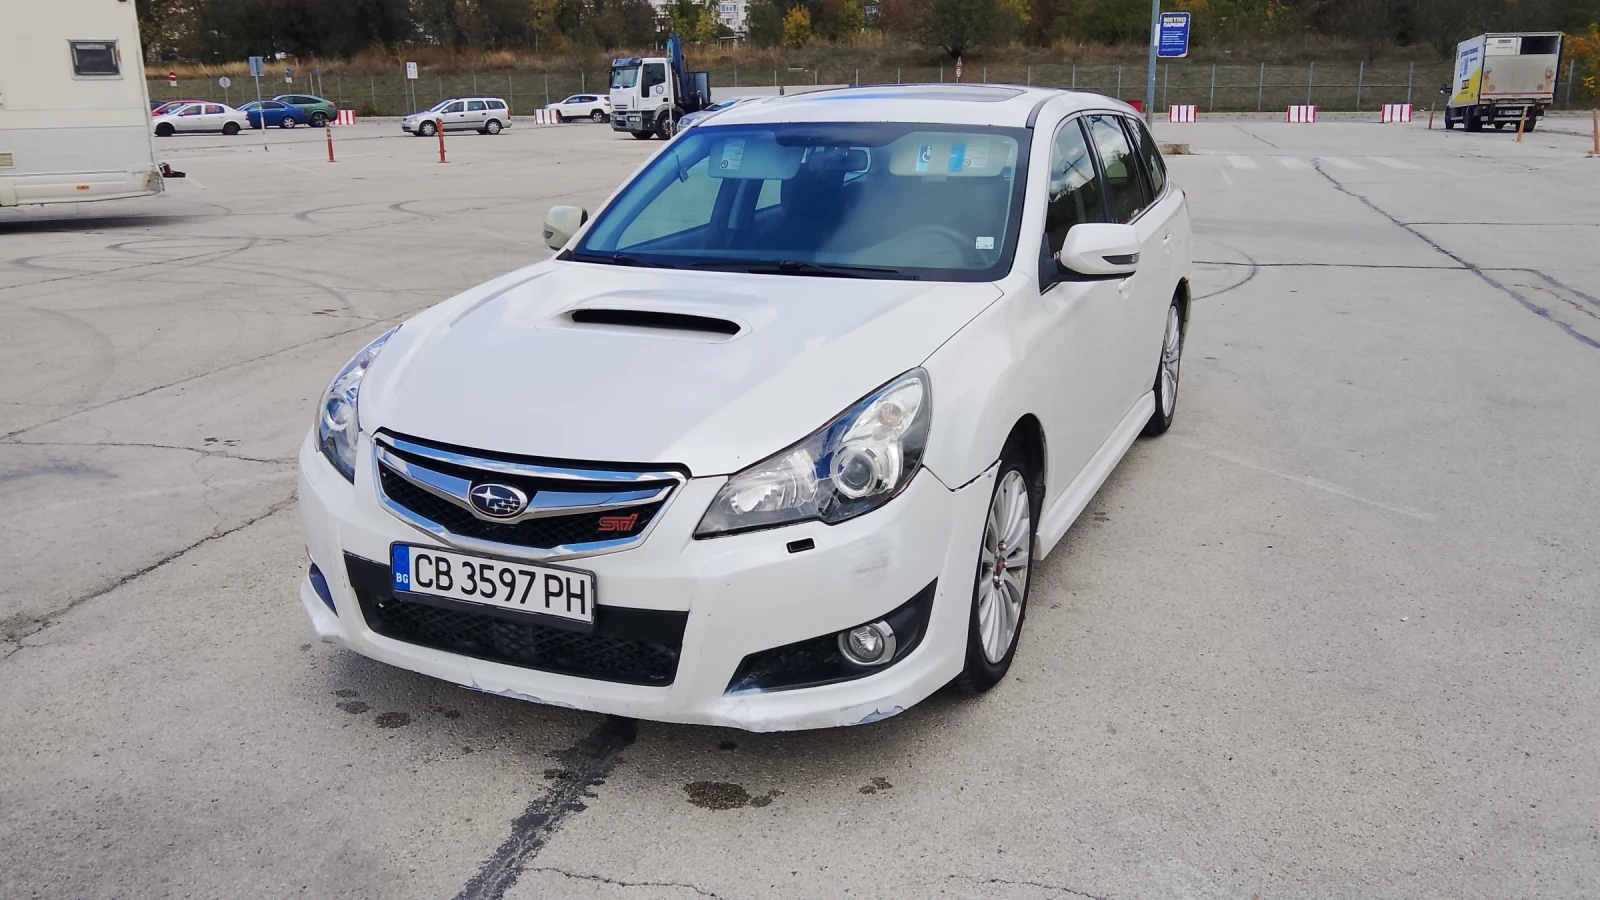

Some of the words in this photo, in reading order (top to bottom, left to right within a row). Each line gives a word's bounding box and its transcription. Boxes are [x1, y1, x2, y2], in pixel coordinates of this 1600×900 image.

[396, 572, 409, 584] BG
[414, 553, 454, 591] CB
[460, 561, 536, 605] 3597
[544, 573, 586, 615] PH
